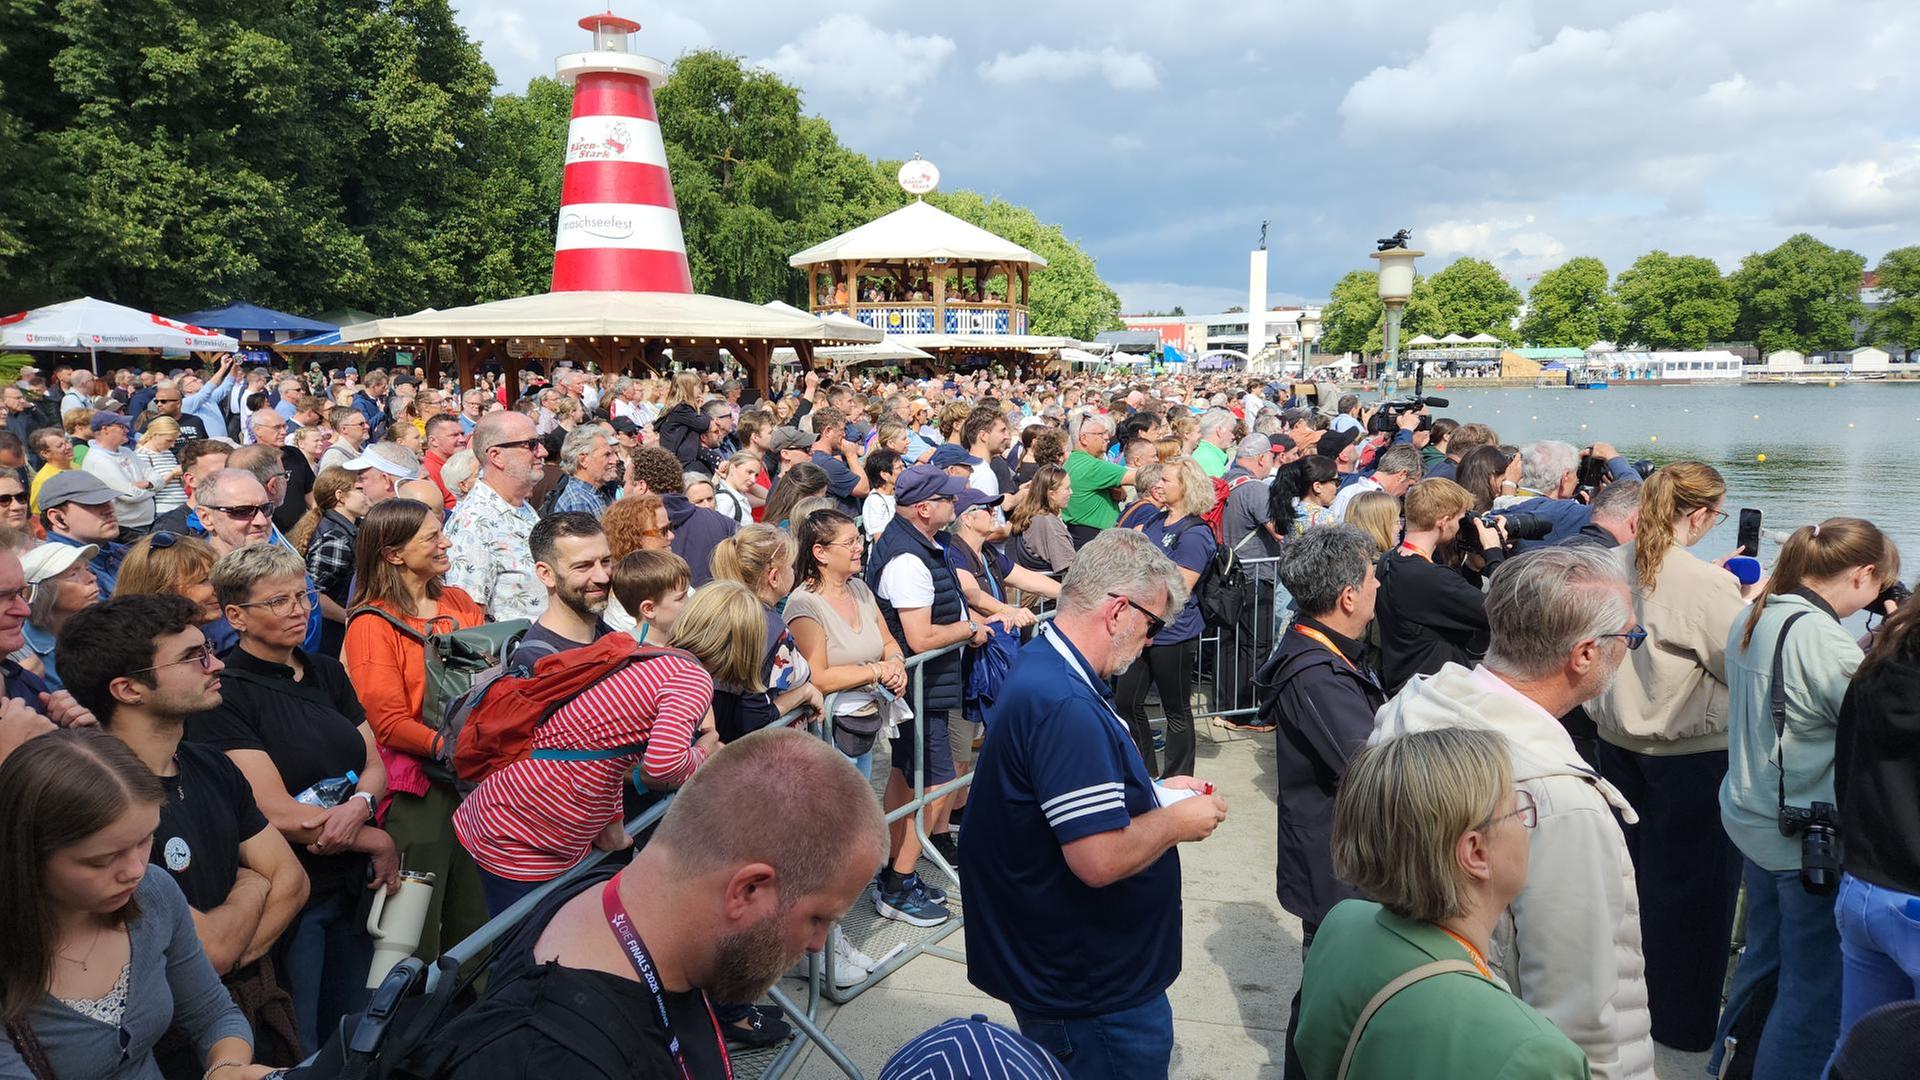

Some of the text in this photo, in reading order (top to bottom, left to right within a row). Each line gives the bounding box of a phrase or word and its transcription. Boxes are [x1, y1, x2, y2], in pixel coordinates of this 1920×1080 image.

[618, 925, 633, 941] DIE
[626, 939, 650, 972] FINALS
[644, 970, 660, 994] 2026
